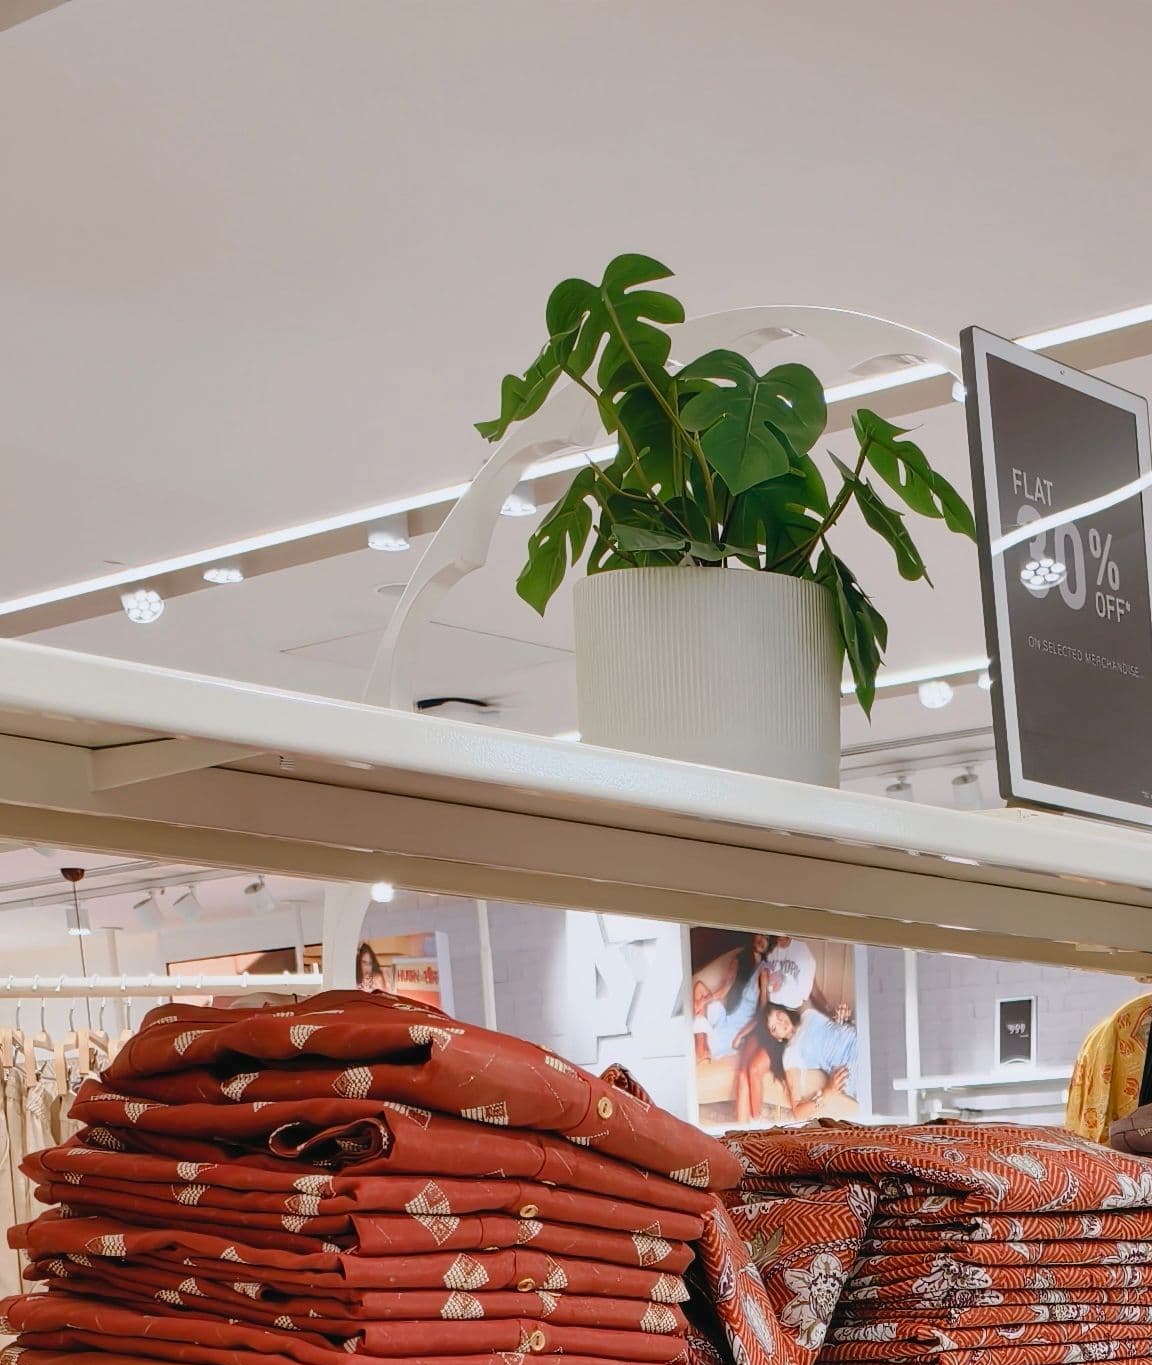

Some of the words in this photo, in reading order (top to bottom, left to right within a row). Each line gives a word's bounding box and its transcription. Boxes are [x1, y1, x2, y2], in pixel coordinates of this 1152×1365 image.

[1012, 467, 1053, 506] FLAT
[1028, 635, 1041, 650] ON
[1043, 639, 1082, 662] SELECTED
